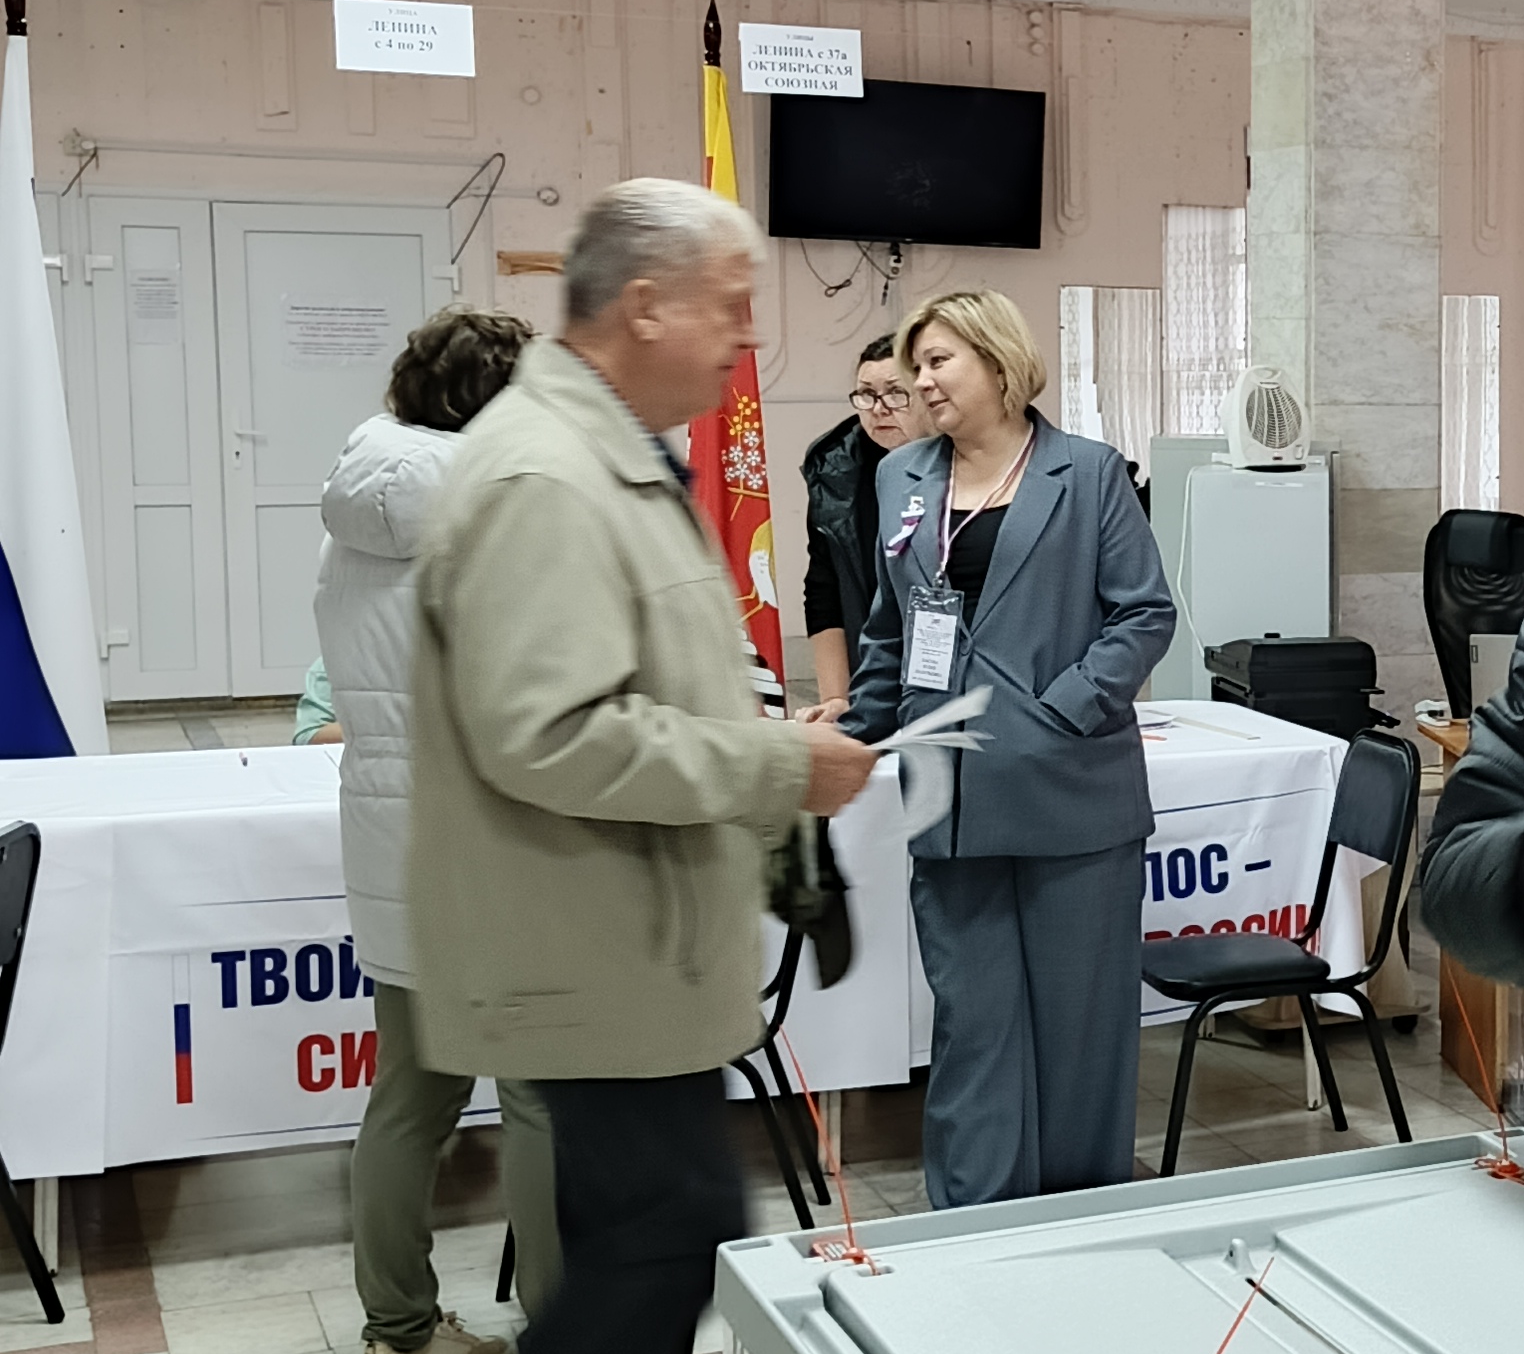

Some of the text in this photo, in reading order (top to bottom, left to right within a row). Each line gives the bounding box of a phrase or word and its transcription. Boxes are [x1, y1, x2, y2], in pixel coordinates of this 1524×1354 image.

[368, 20, 438, 36] ЛЕНИНА
[374, 39, 433, 52] с 4 по 29
[752, 44, 847, 60] ЛЕНИНА с 37а
[748, 60, 853, 76] ОКТЯБРЬСКАЯ
[764, 76, 838, 91] СОЮЗНАЯ
[1145, 843, 1229, 902] ЛОС
[297, 1030, 378, 1092] СИ
